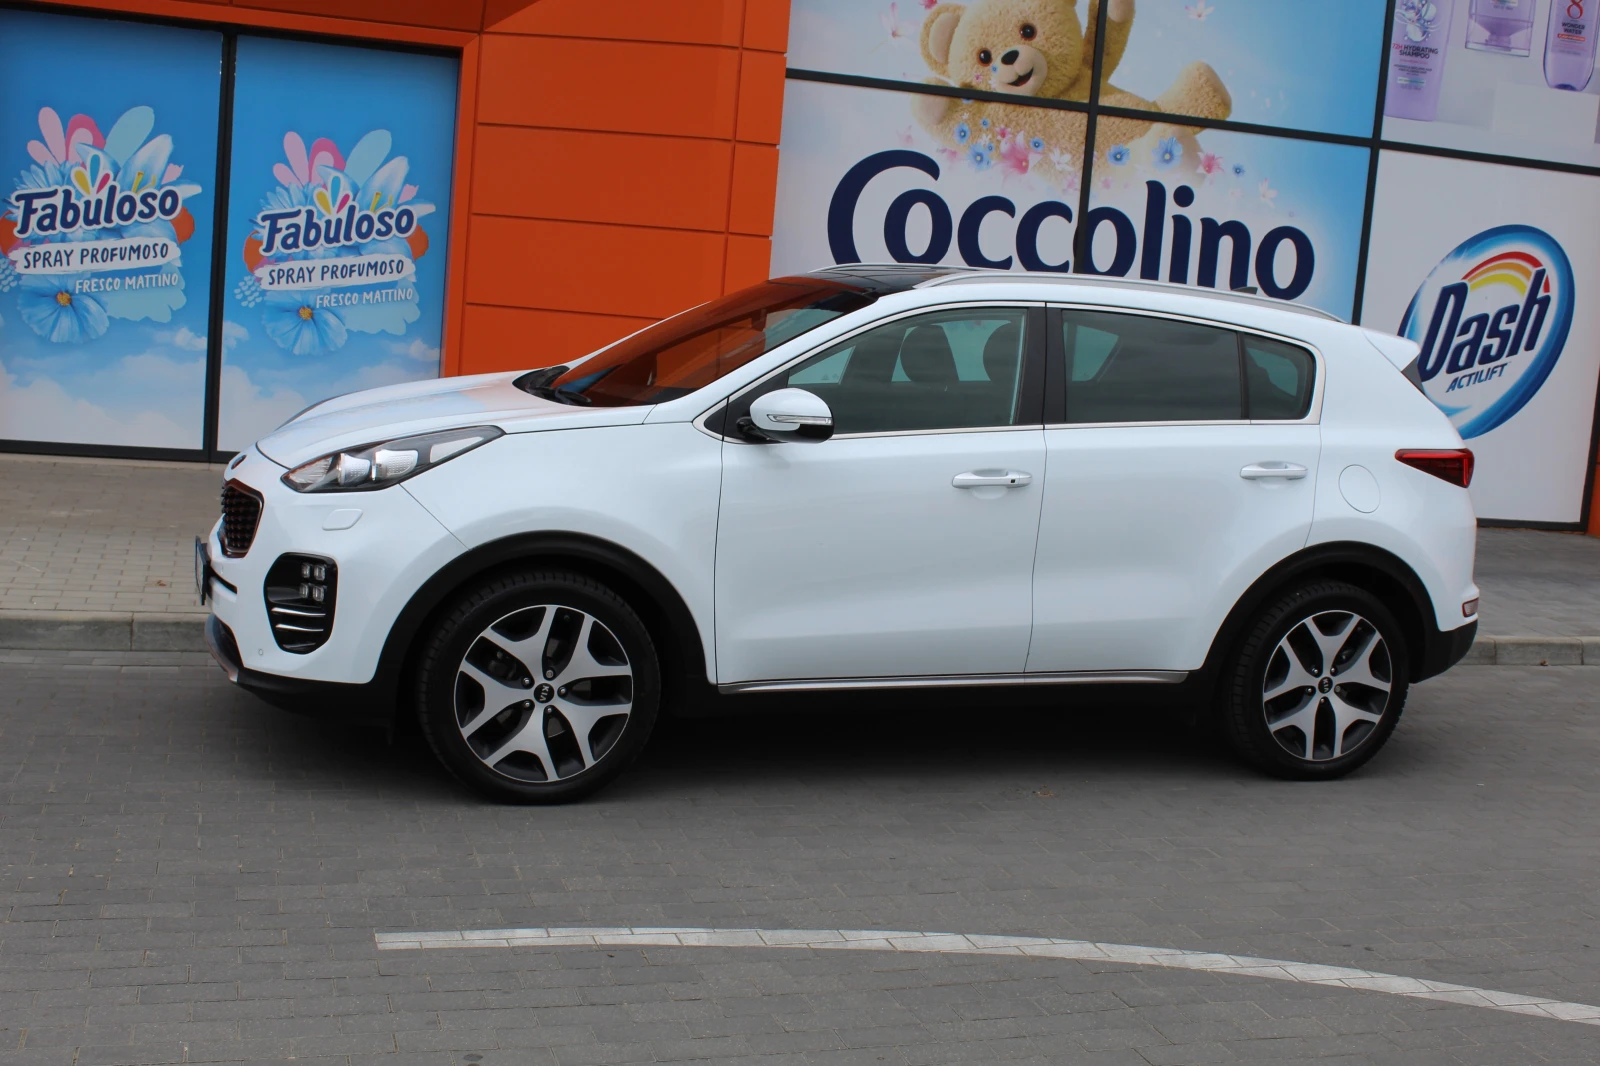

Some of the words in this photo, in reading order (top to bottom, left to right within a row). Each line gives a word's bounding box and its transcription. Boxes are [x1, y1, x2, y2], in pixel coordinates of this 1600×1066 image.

[1561, 22, 1585, 30] WONDER
[1399, 50, 1430, 59] SHAMPOO
[1403, 44, 1438, 54] HYDRATING
[14, 184, 179, 235] Fabuloso
[261, 204, 414, 253] Fabuloso
[827, 149, 1315, 300] Coccolino
[24, 248, 74, 269] SPRAY
[80, 243, 169, 265] PROFUMOSO
[75, 278, 121, 294] FRESCO
[124, 273, 179, 290] MATTINO
[268, 266, 316, 285] SPRAY
[321, 259, 404, 281] PROFUMOSO
[316, 293, 358, 309] FRESCO
[362, 289, 413, 305] MATTINO
[1417, 268, 1551, 382] Dash
[1446, 363, 1508, 393] ACTILIFT
[539, 685, 550, 701] KIA
